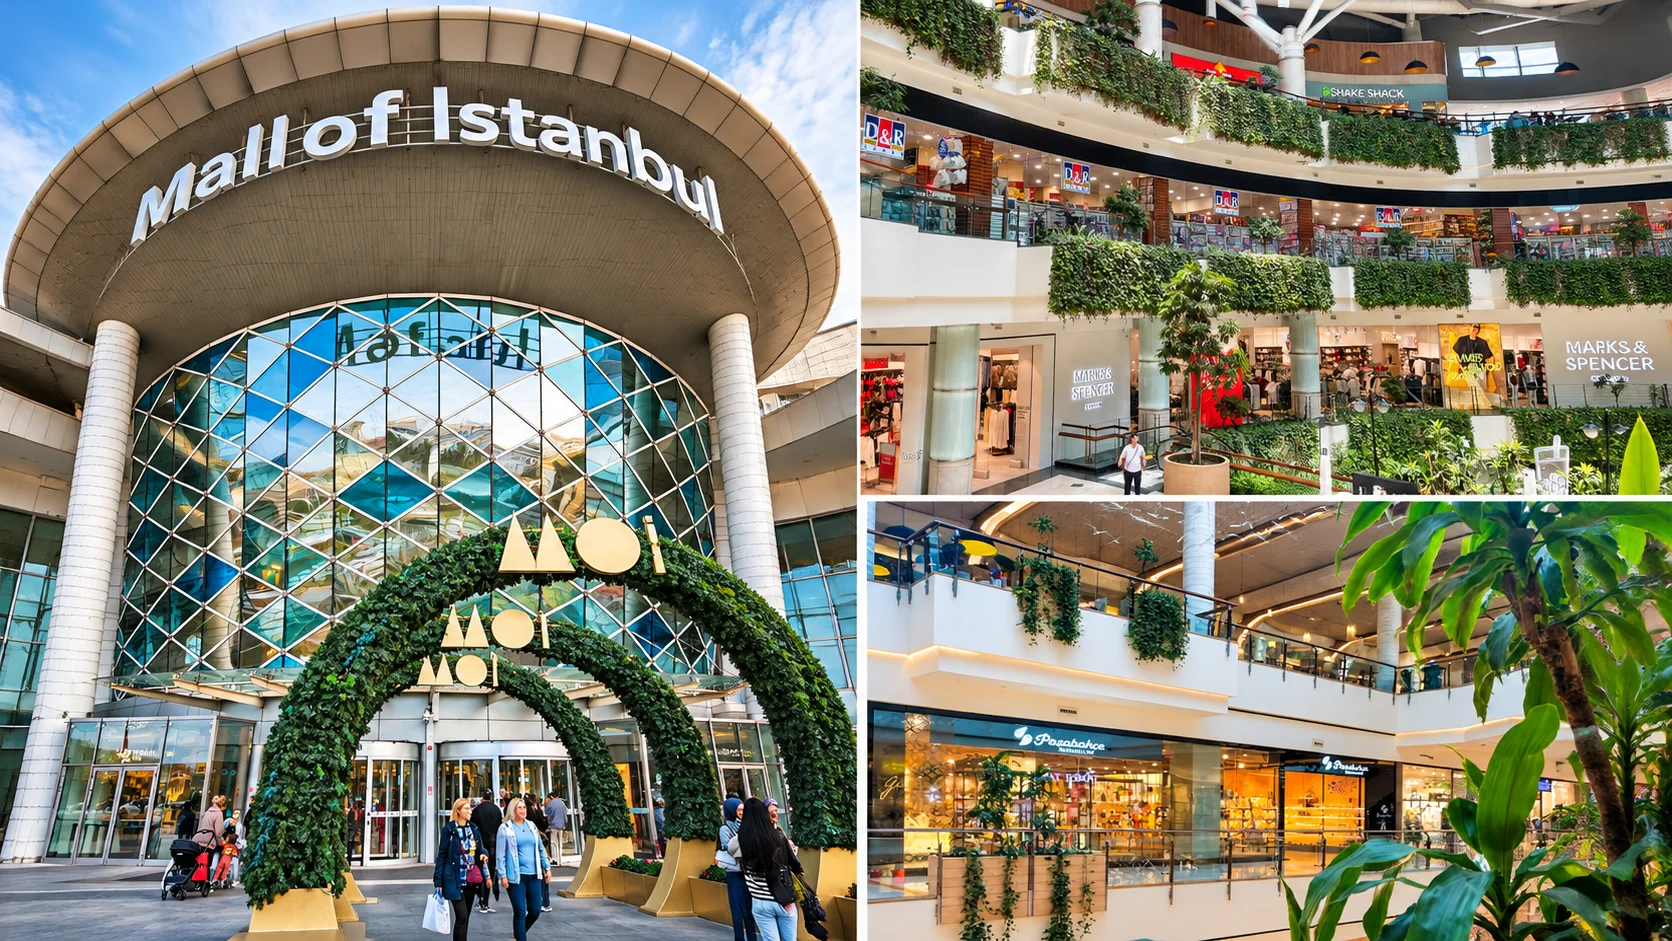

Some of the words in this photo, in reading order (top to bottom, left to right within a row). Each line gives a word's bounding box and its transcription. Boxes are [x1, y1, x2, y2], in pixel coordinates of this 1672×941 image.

[1331, 87, 1365, 98] SHAKE
[1367, 88, 1405, 98] SHACK
[865, 120, 904, 147] D&R
[130, 114, 290, 247] Mall
[303, 89, 404, 161] of
[433, 86, 725, 237] Istanbul
[1565, 340, 1631, 355] MARKS
[1633, 340, 1649, 355] &
[1565, 357, 1656, 372] SPENCER
